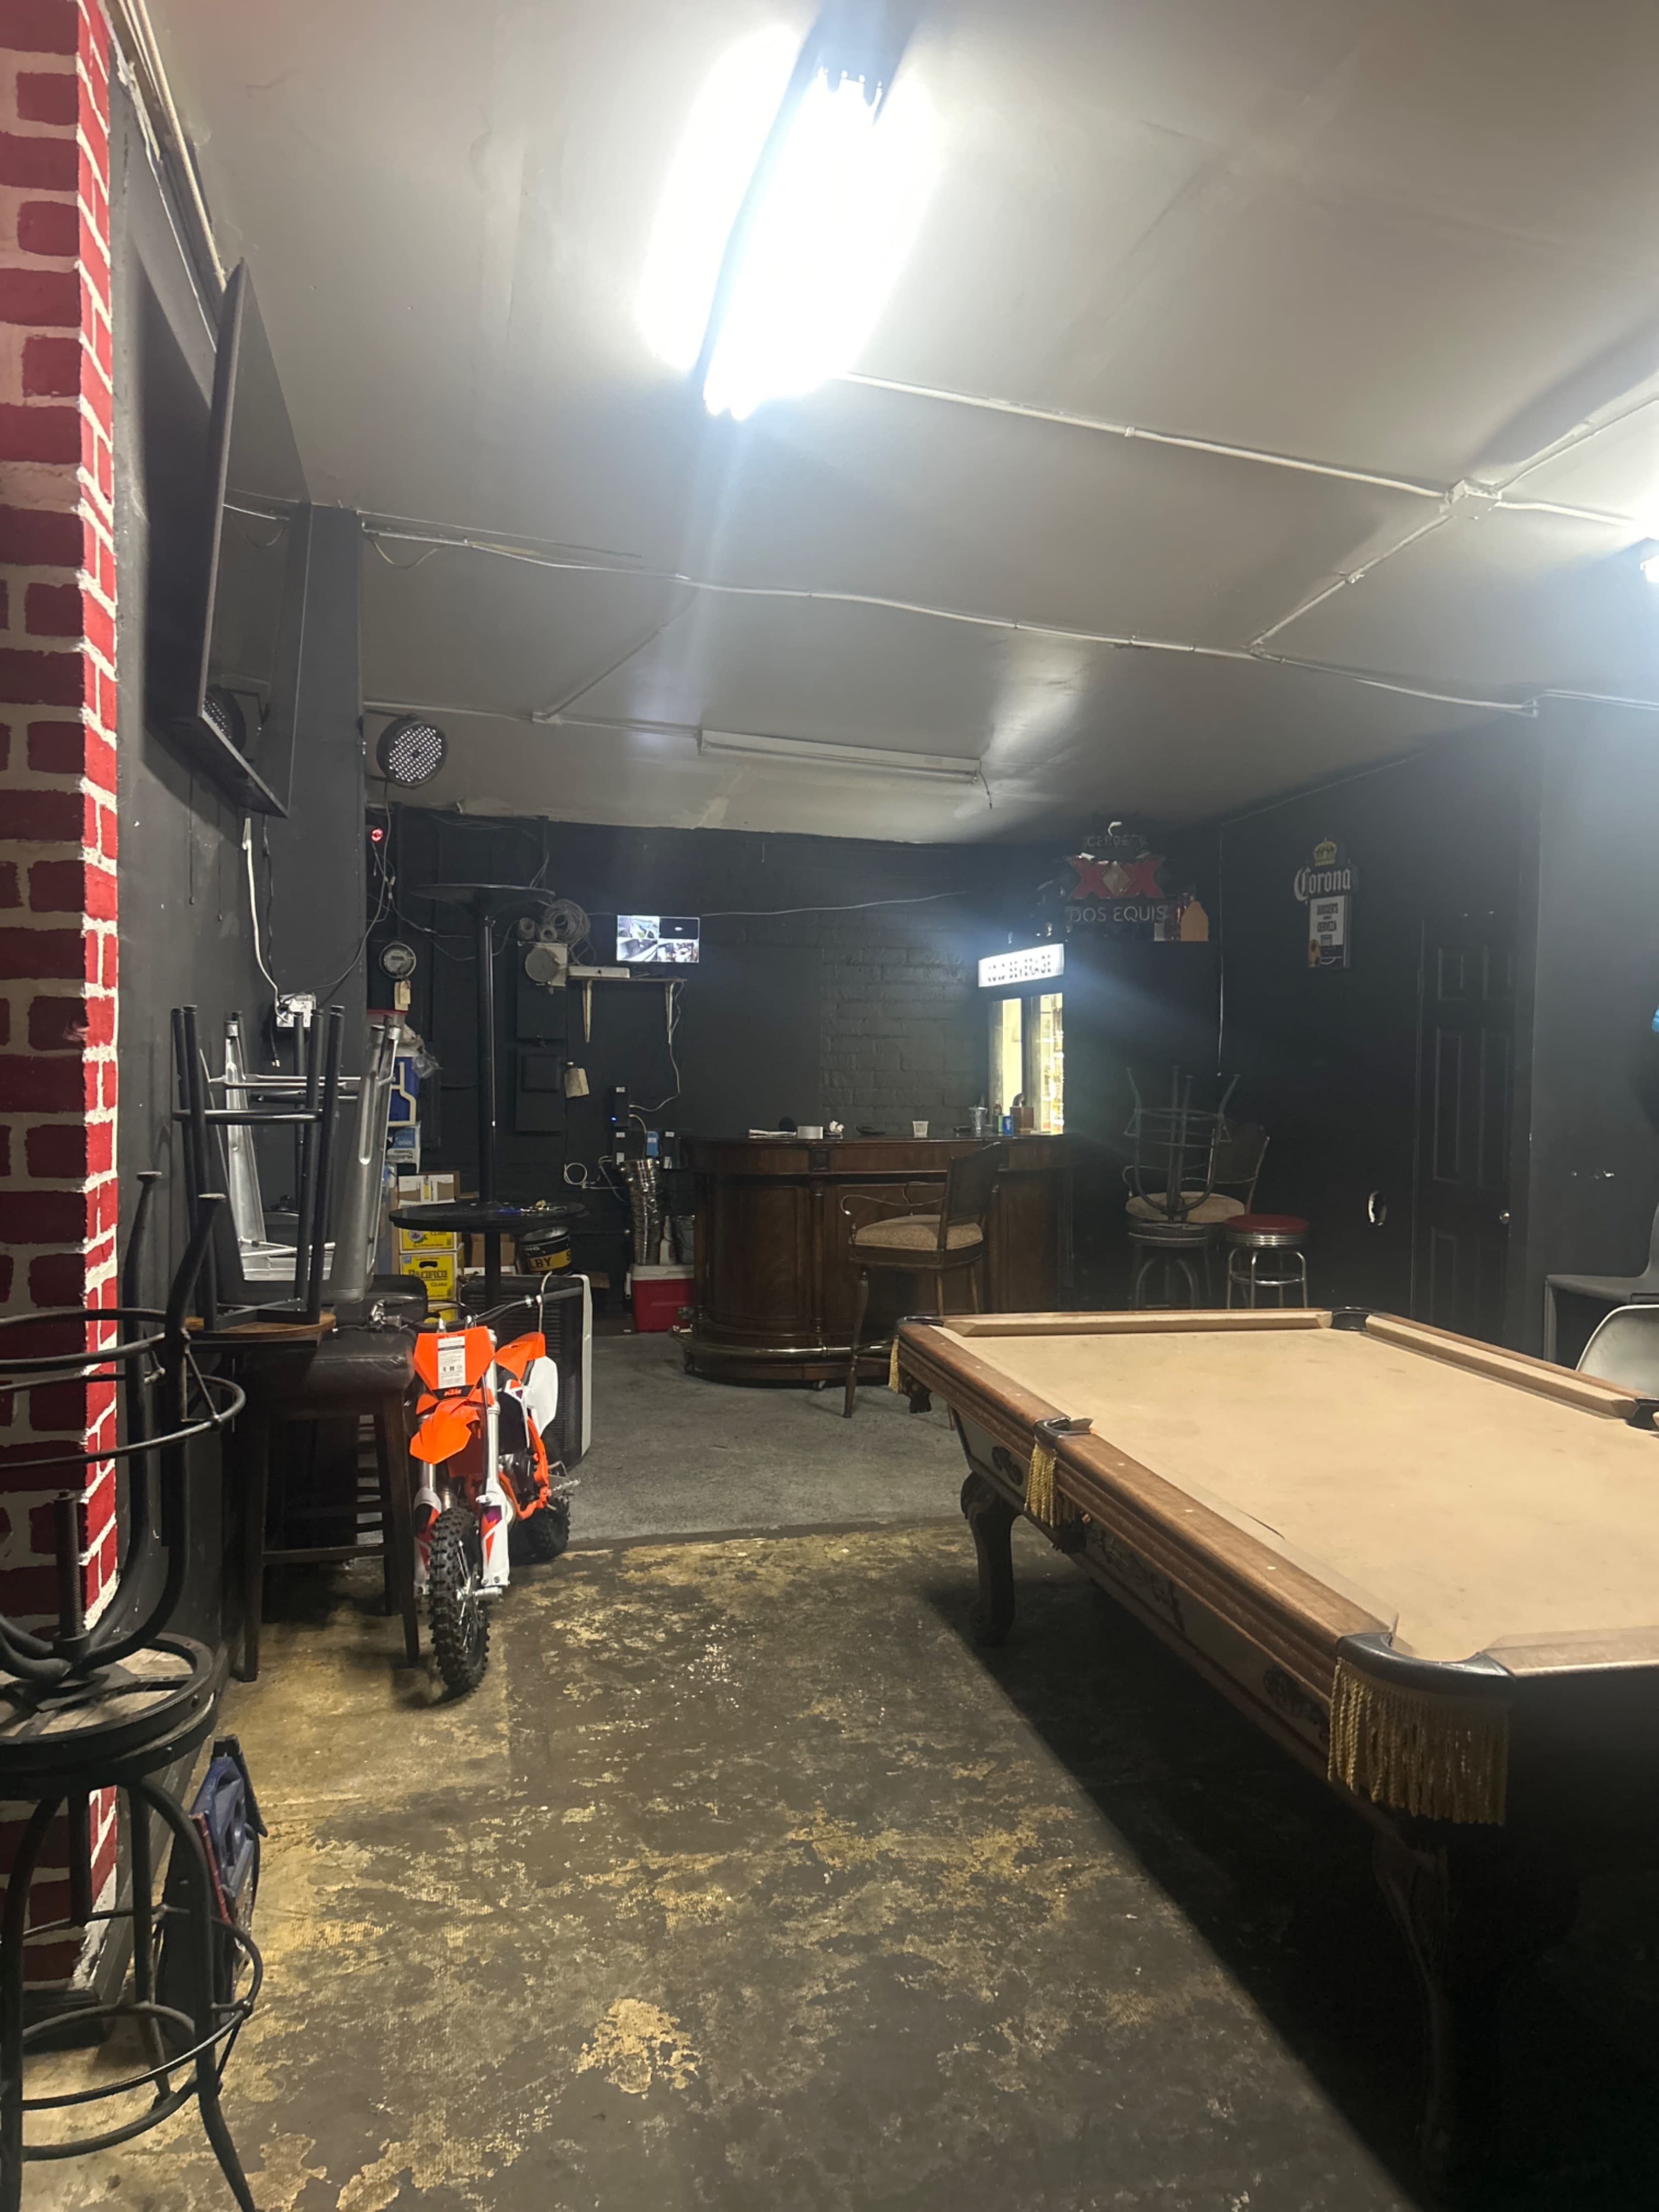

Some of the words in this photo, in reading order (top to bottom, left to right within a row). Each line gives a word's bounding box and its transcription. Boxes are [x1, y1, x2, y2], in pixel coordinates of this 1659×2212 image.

[1294, 866, 1351, 901] Corona
[1069, 907, 1106, 922] DOS
[1113, 906, 1166, 922] EQUIS
